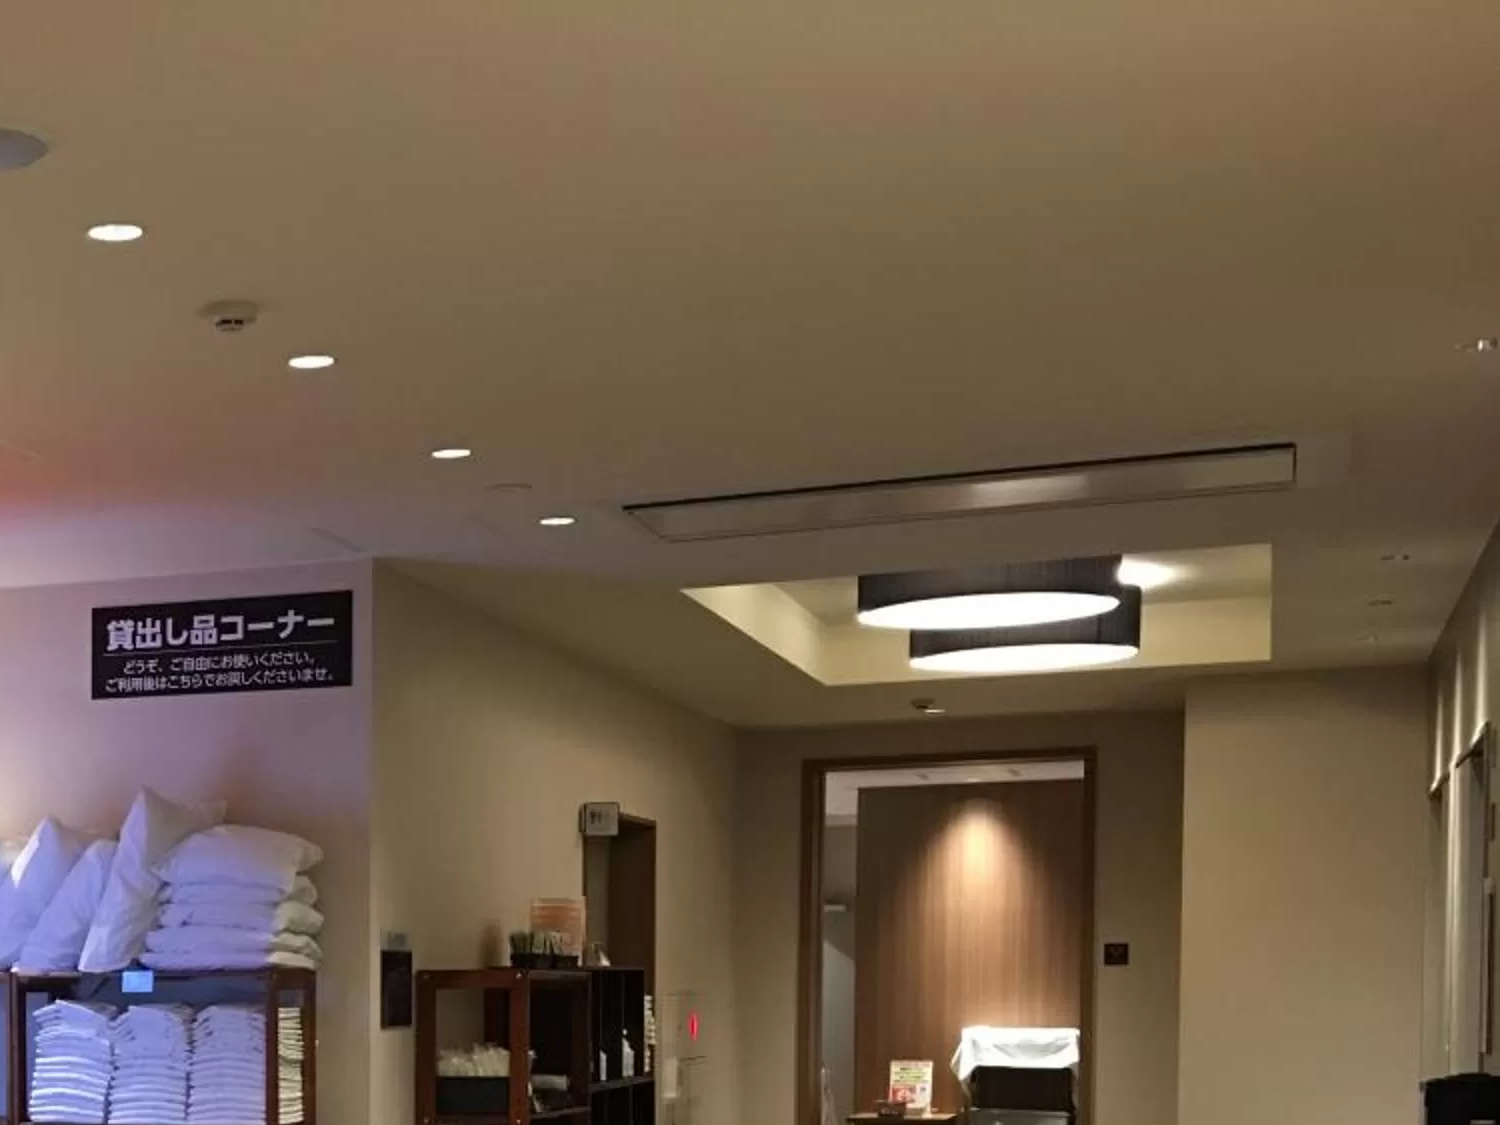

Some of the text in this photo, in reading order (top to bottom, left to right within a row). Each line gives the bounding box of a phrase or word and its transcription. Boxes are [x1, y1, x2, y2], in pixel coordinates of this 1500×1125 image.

[106, 609, 335, 651] 貸出し品コーナー
